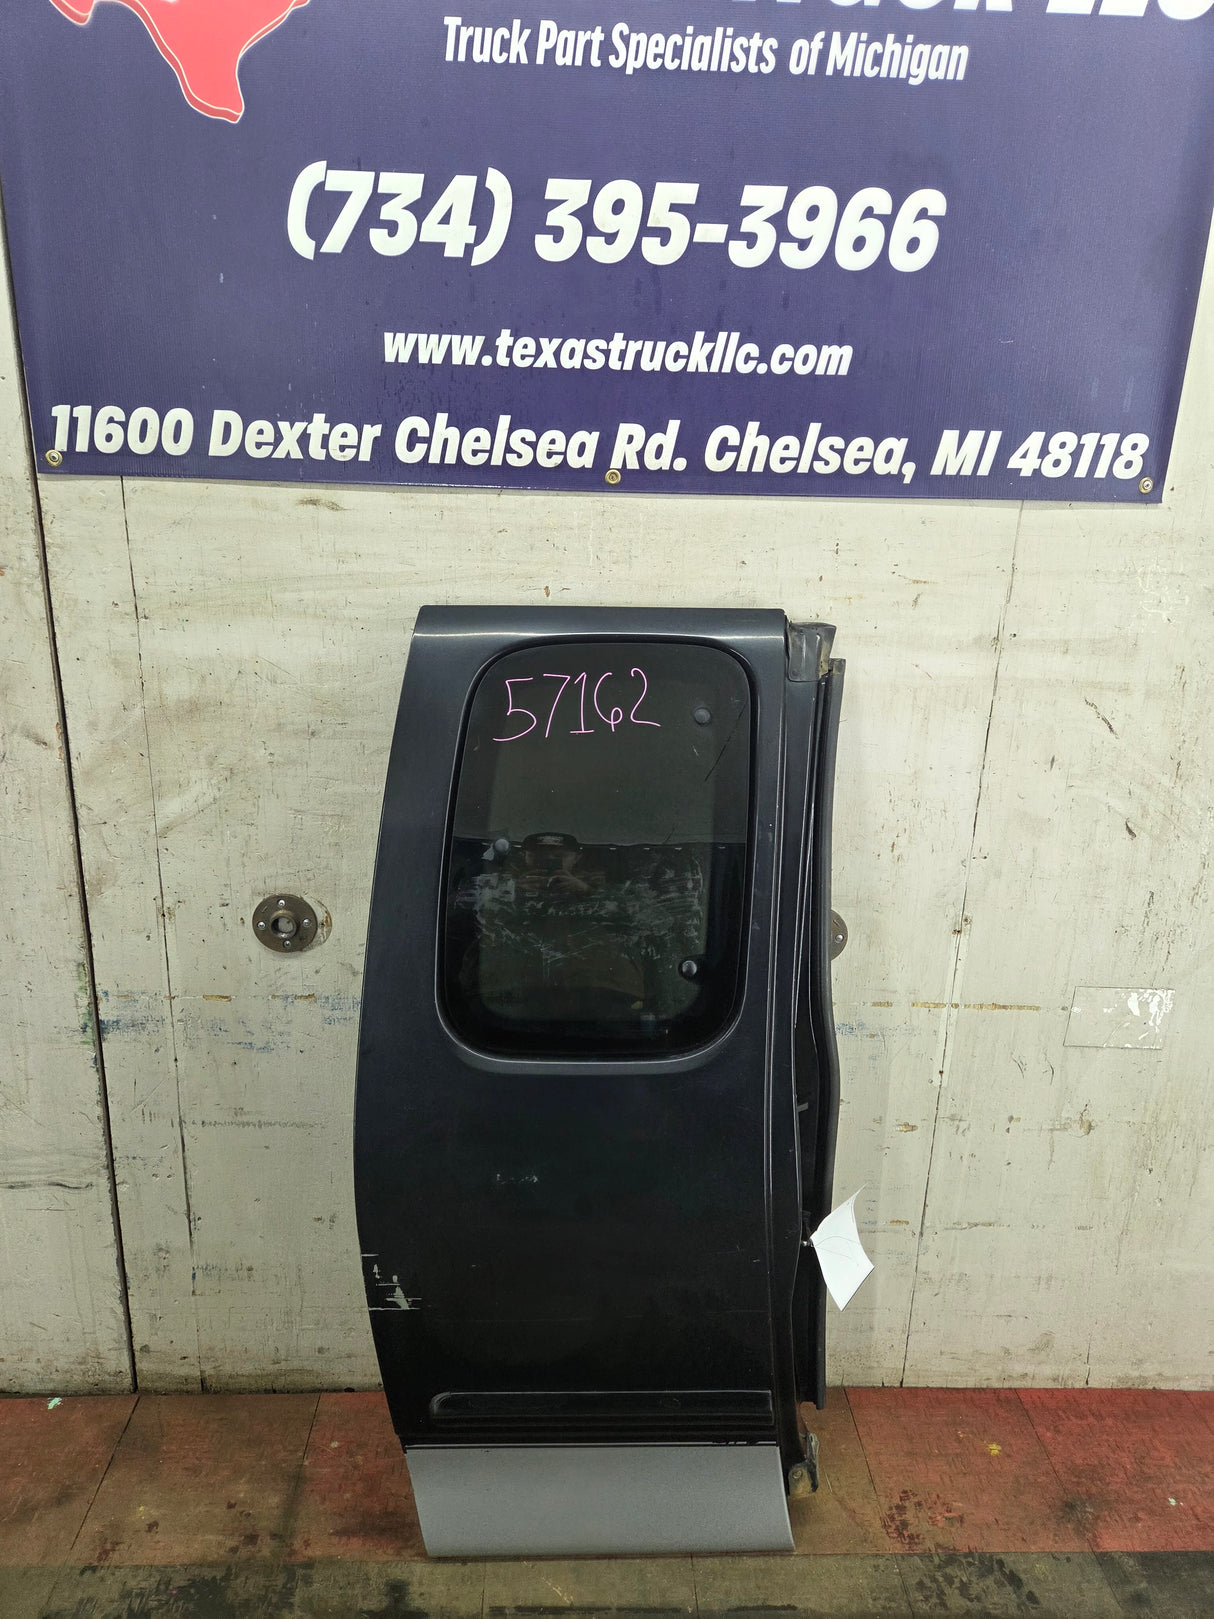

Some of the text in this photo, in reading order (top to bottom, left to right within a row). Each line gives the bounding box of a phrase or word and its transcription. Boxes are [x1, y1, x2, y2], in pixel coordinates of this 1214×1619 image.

[443, 17, 970, 86] Truck Part Specialists of Michigan
[287, 160, 948, 273] (734) 395-3966
[383, 328, 854, 376] www.texastruckllc.com
[51, 404, 1150, 484] 11600 Dexter Chelsea Rd. Chelsea, MI 48118
[492, 667, 661, 742] 57162
